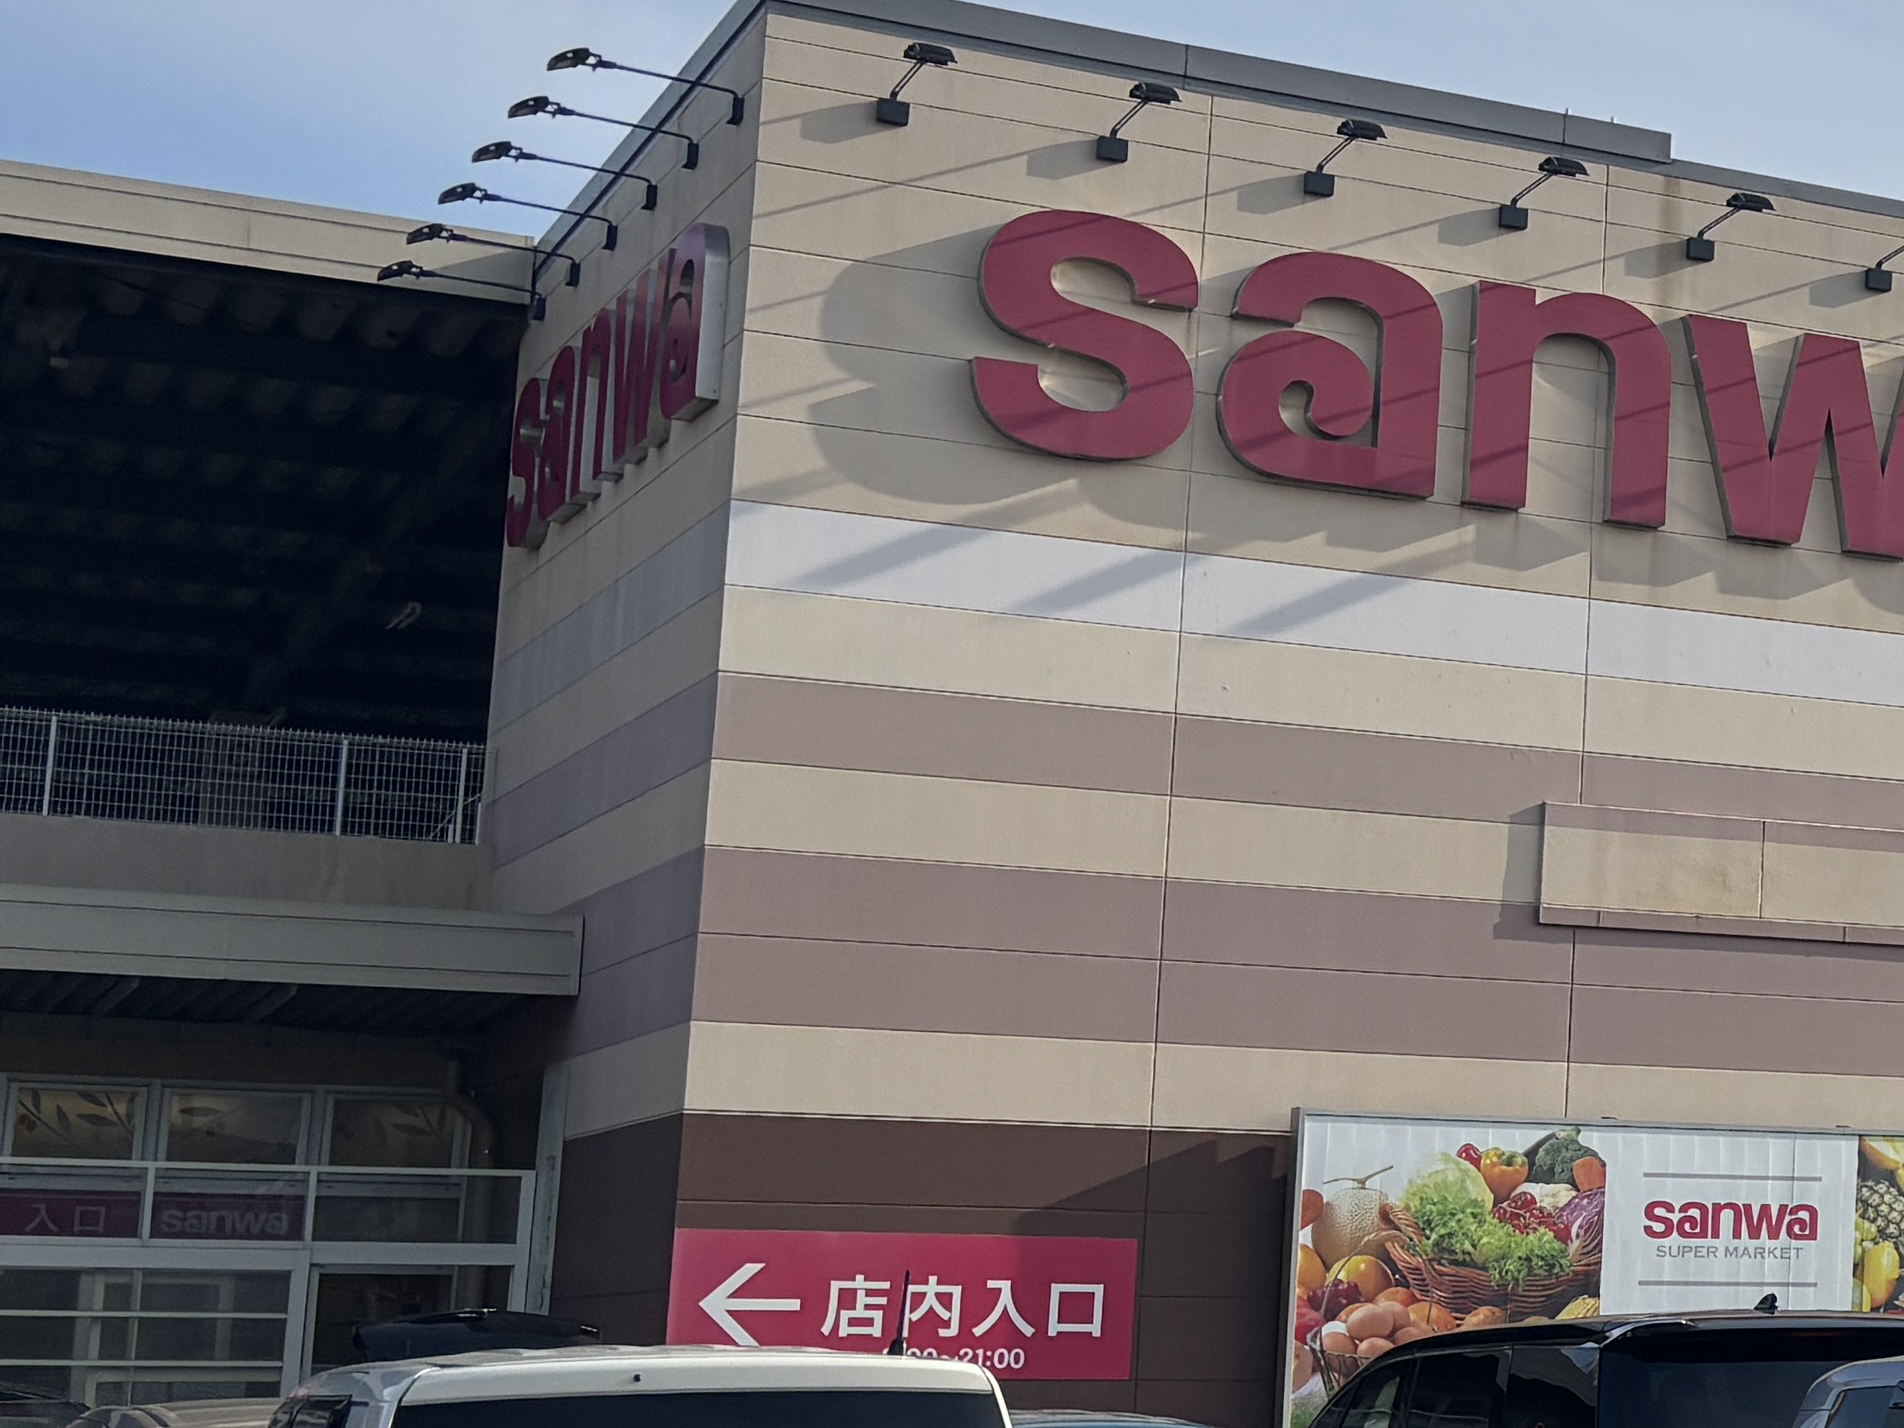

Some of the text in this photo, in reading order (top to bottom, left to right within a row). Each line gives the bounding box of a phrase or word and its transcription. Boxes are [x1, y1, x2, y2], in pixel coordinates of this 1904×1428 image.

[506, 223, 726, 549] sanwa
[160, 1209, 289, 1235] sanwa
[1643, 1200, 1819, 1241] sanwa
[1656, 1245, 1804, 1260] SUPER MARKET
[820, 1275, 1105, 1338] 店内入口
